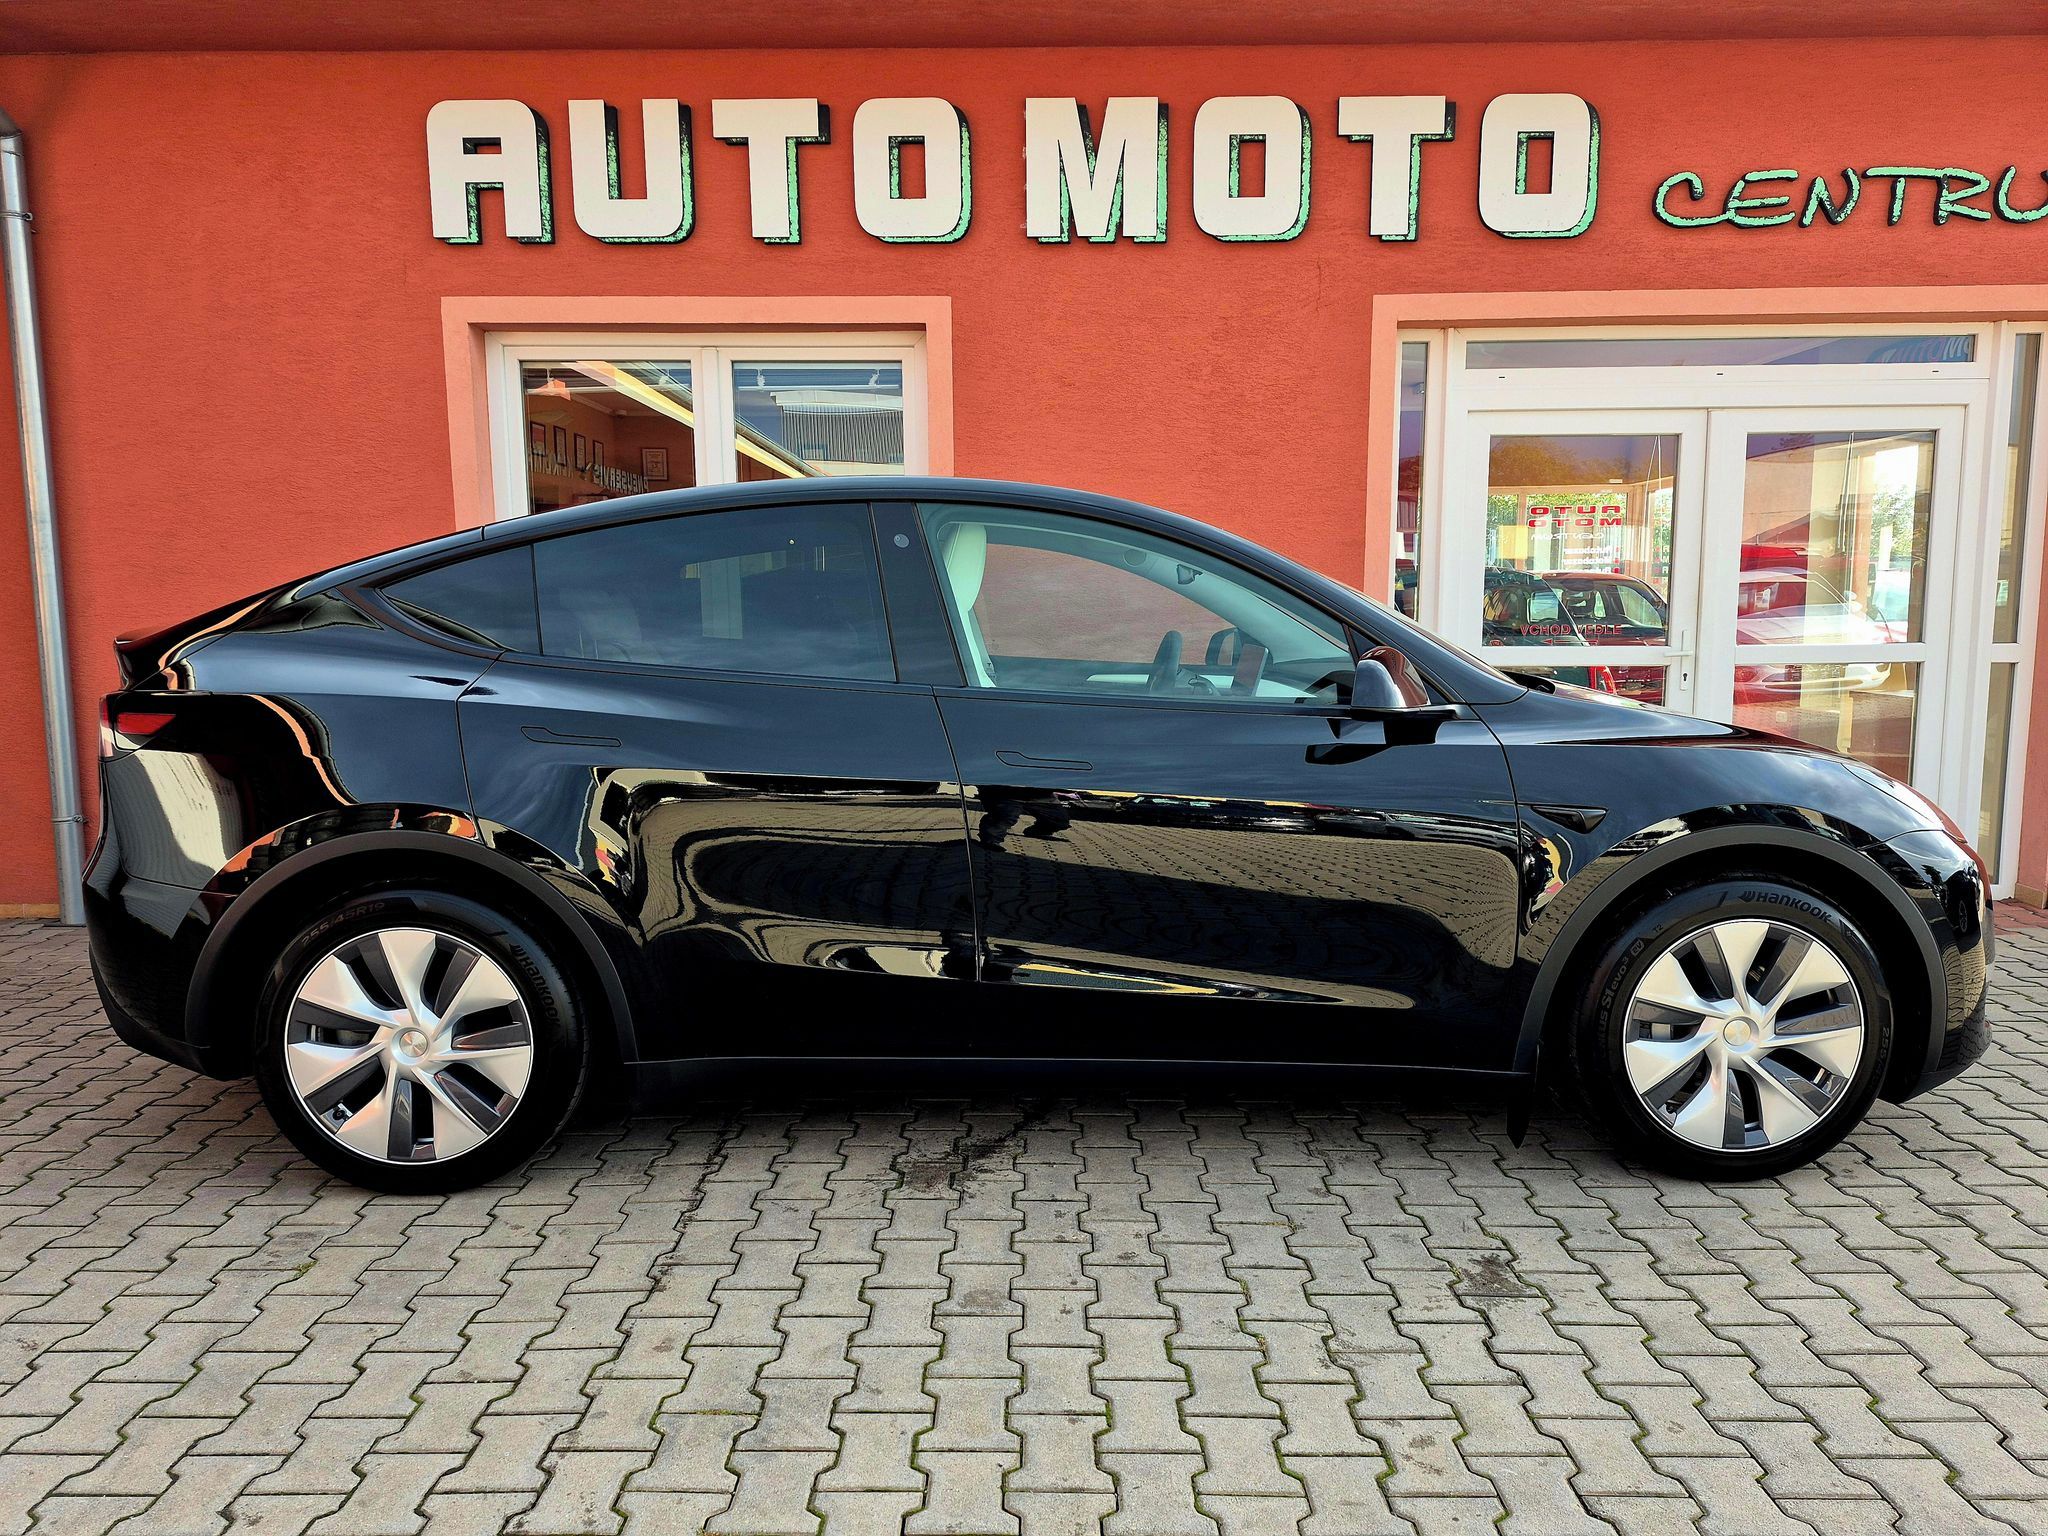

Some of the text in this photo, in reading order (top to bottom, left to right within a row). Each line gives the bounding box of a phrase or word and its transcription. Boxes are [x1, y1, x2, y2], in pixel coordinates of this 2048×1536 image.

[426, 97, 972, 244] AUTO
[1024, 93, 1601, 243] MOTO
[1519, 623, 1622, 636] VCHOD VEDLE
